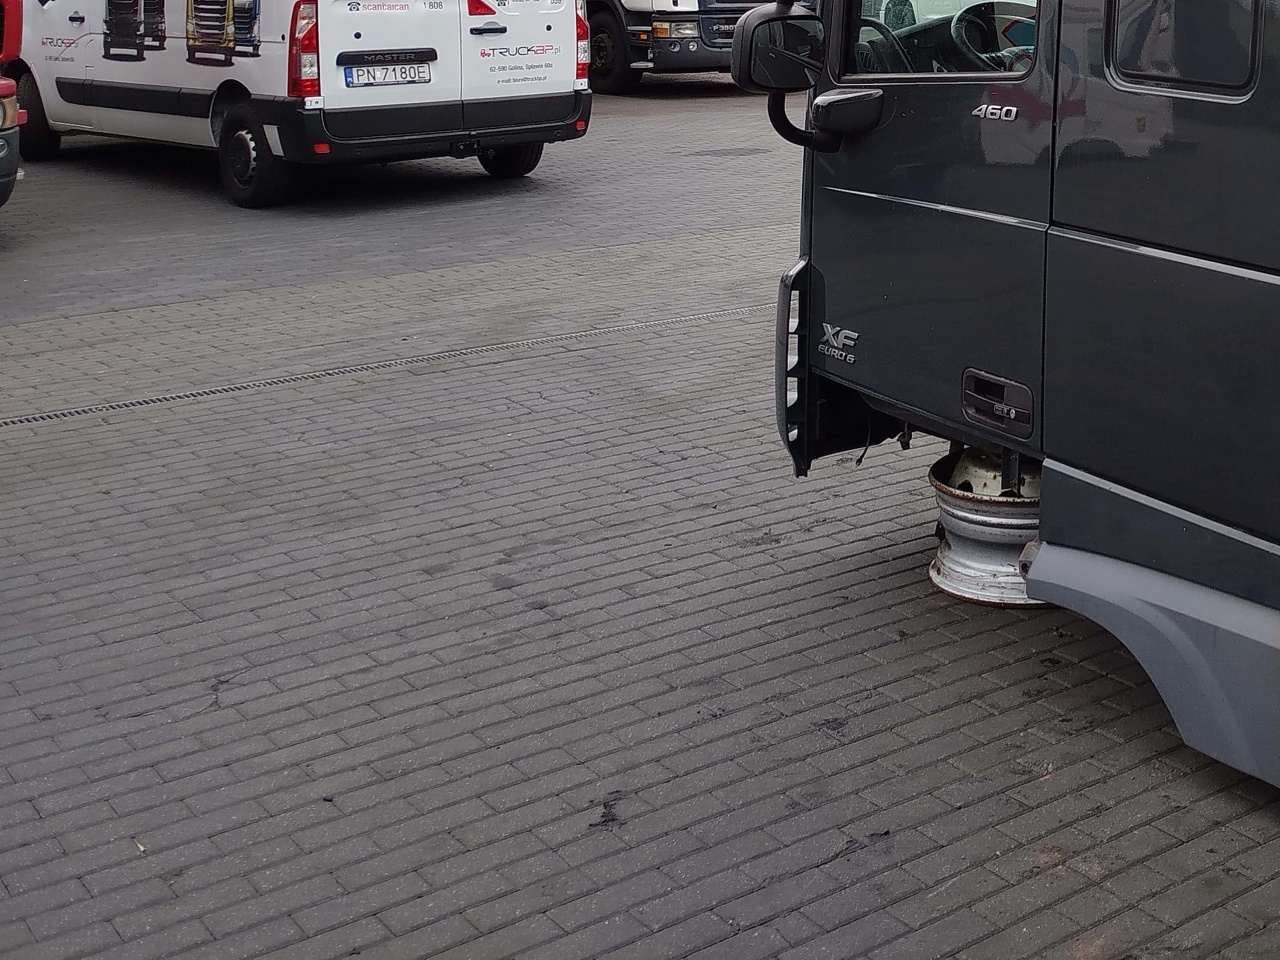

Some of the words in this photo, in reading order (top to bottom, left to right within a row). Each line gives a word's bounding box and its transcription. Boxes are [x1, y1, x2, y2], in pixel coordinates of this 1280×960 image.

[363, 53, 416, 62] MASTER
[356, 68, 376, 83] PN
[380, 66, 427, 81] 7180E
[971, 104, 1018, 121] 460
[820, 322, 859, 349] XF
[818, 344, 846, 361] EURO
[846, 353, 856, 364] 6
